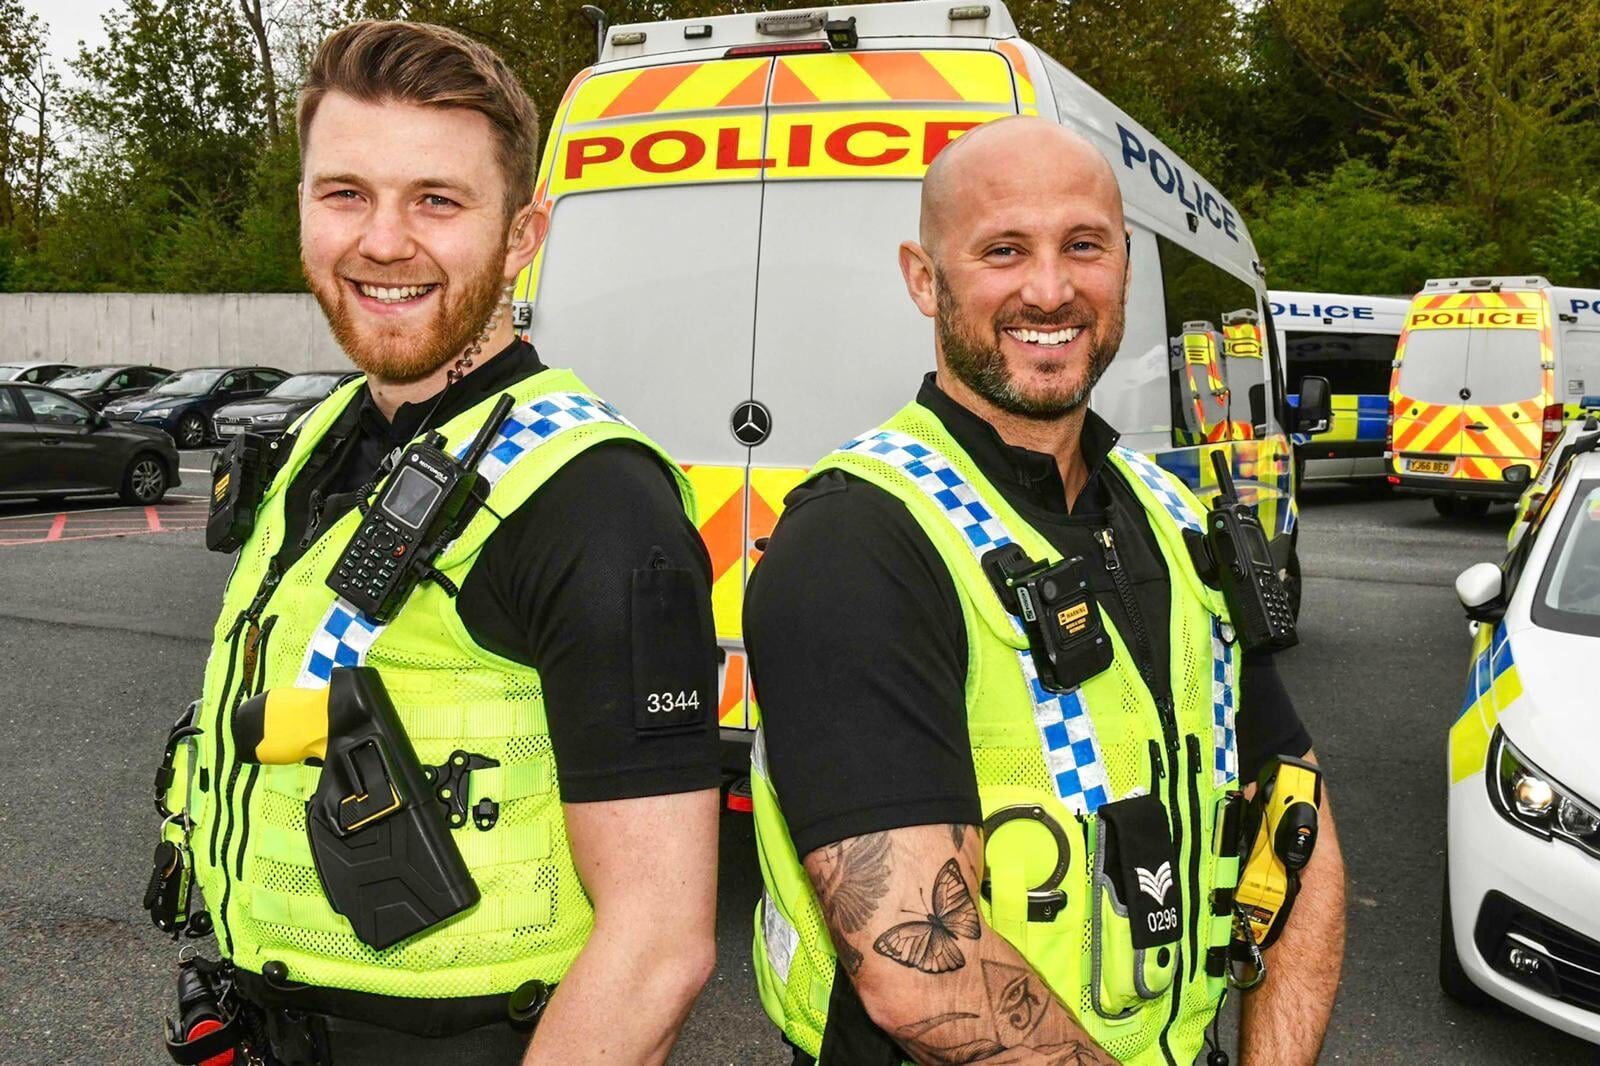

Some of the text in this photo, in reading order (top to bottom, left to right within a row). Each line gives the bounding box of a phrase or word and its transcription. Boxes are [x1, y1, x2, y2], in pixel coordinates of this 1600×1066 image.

[1115, 121, 1239, 243] POLICE
[1269, 302, 1375, 320] OLICE
[1412, 312, 1538, 326] POLICE
[418, 460, 448, 481] MOTOROLA
[647, 690, 700, 713] 3344
[1147, 907, 1178, 933] 0296
